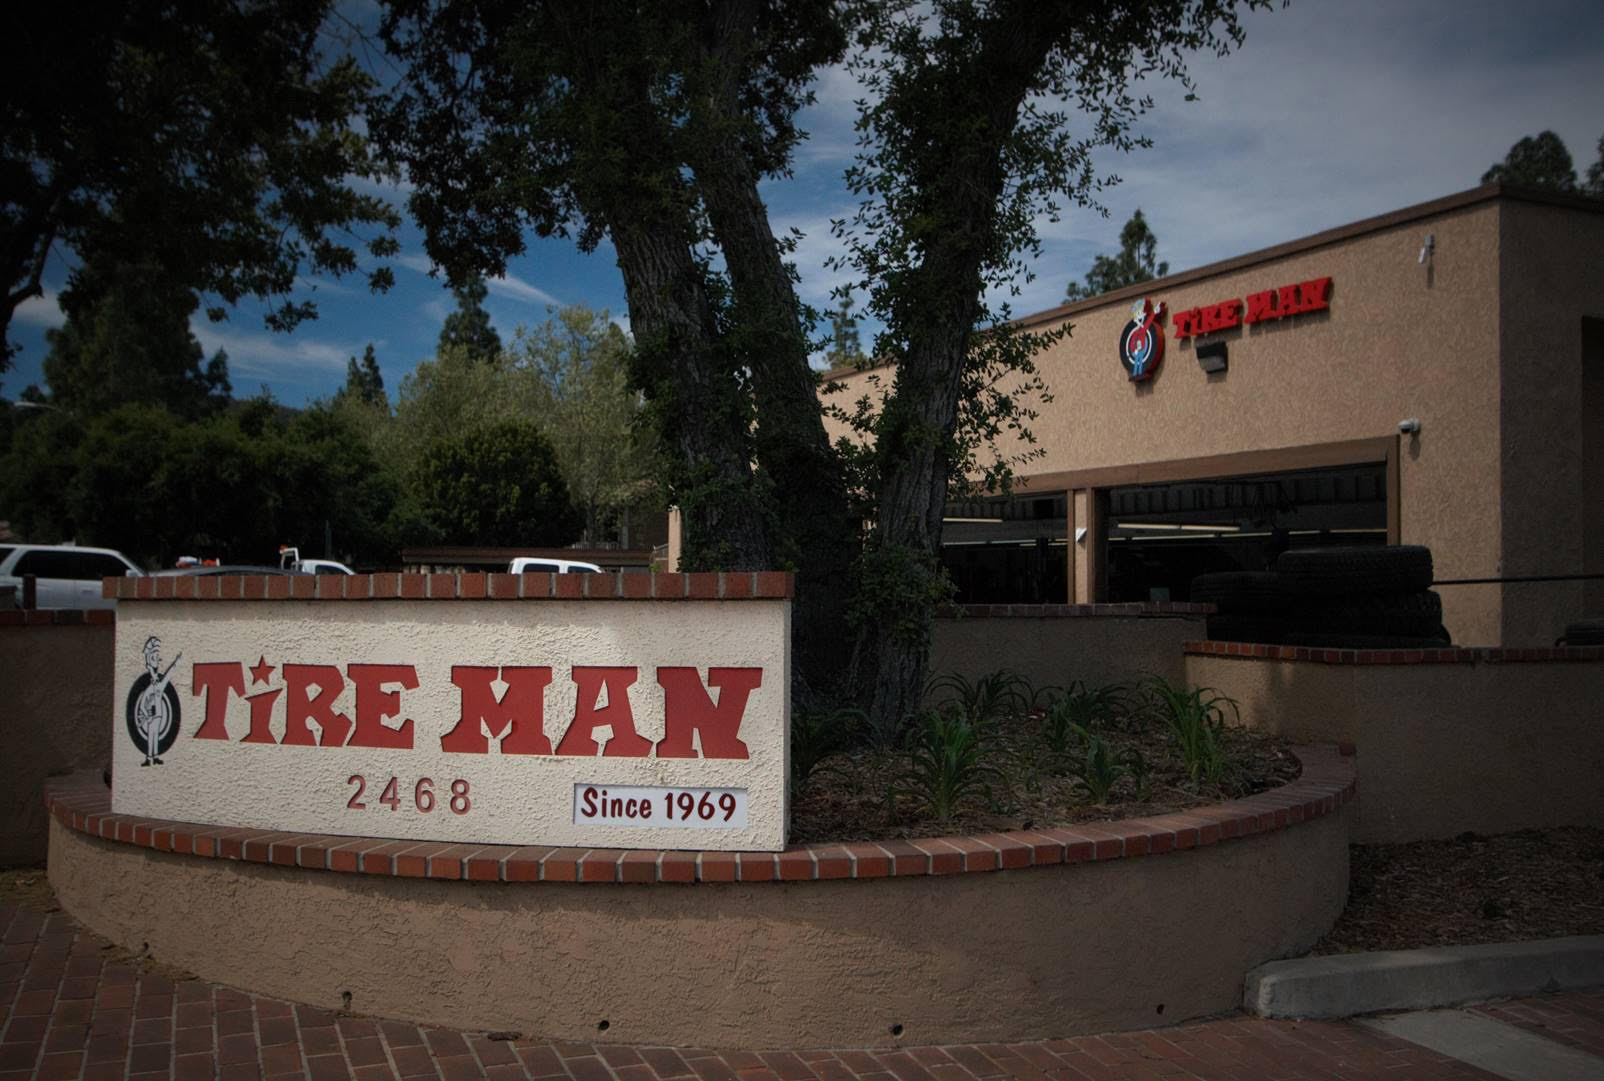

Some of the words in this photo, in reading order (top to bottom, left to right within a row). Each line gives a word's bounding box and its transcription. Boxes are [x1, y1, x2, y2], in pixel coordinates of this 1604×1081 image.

[1245, 278, 1331, 324] MAN
[440, 665, 763, 759] MAN
[347, 775, 472, 816] 2468
[581, 786, 652, 819] Since
[665, 791, 736, 822] 1969
